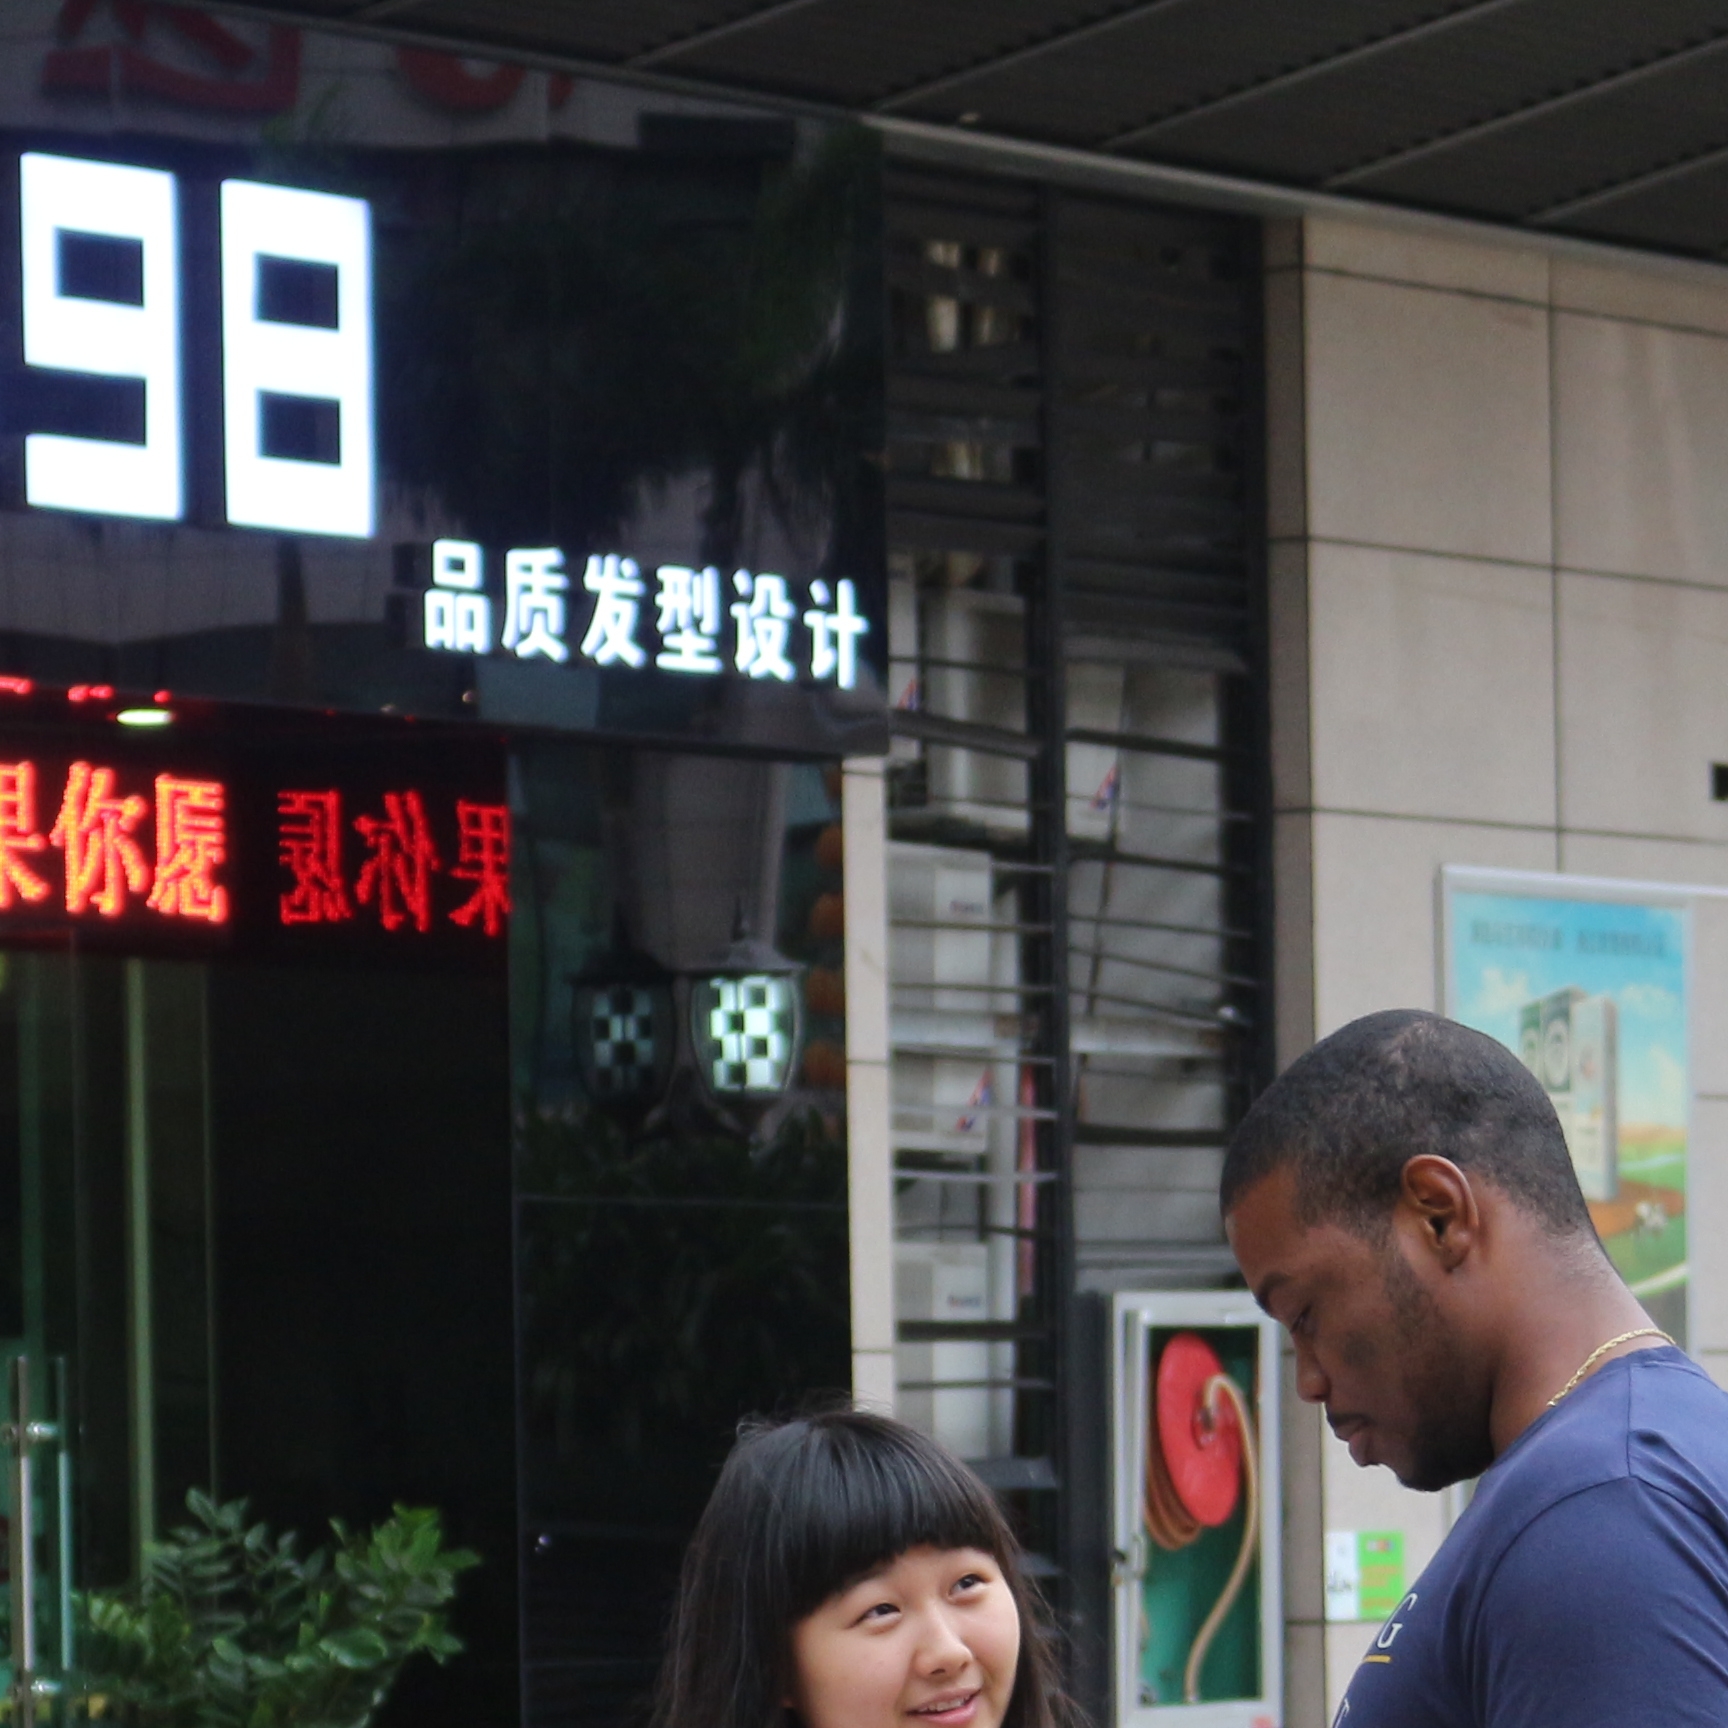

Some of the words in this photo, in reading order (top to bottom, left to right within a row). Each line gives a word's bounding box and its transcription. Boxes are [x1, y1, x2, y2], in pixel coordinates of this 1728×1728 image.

[423, 538, 870, 691] 品质发型设计
